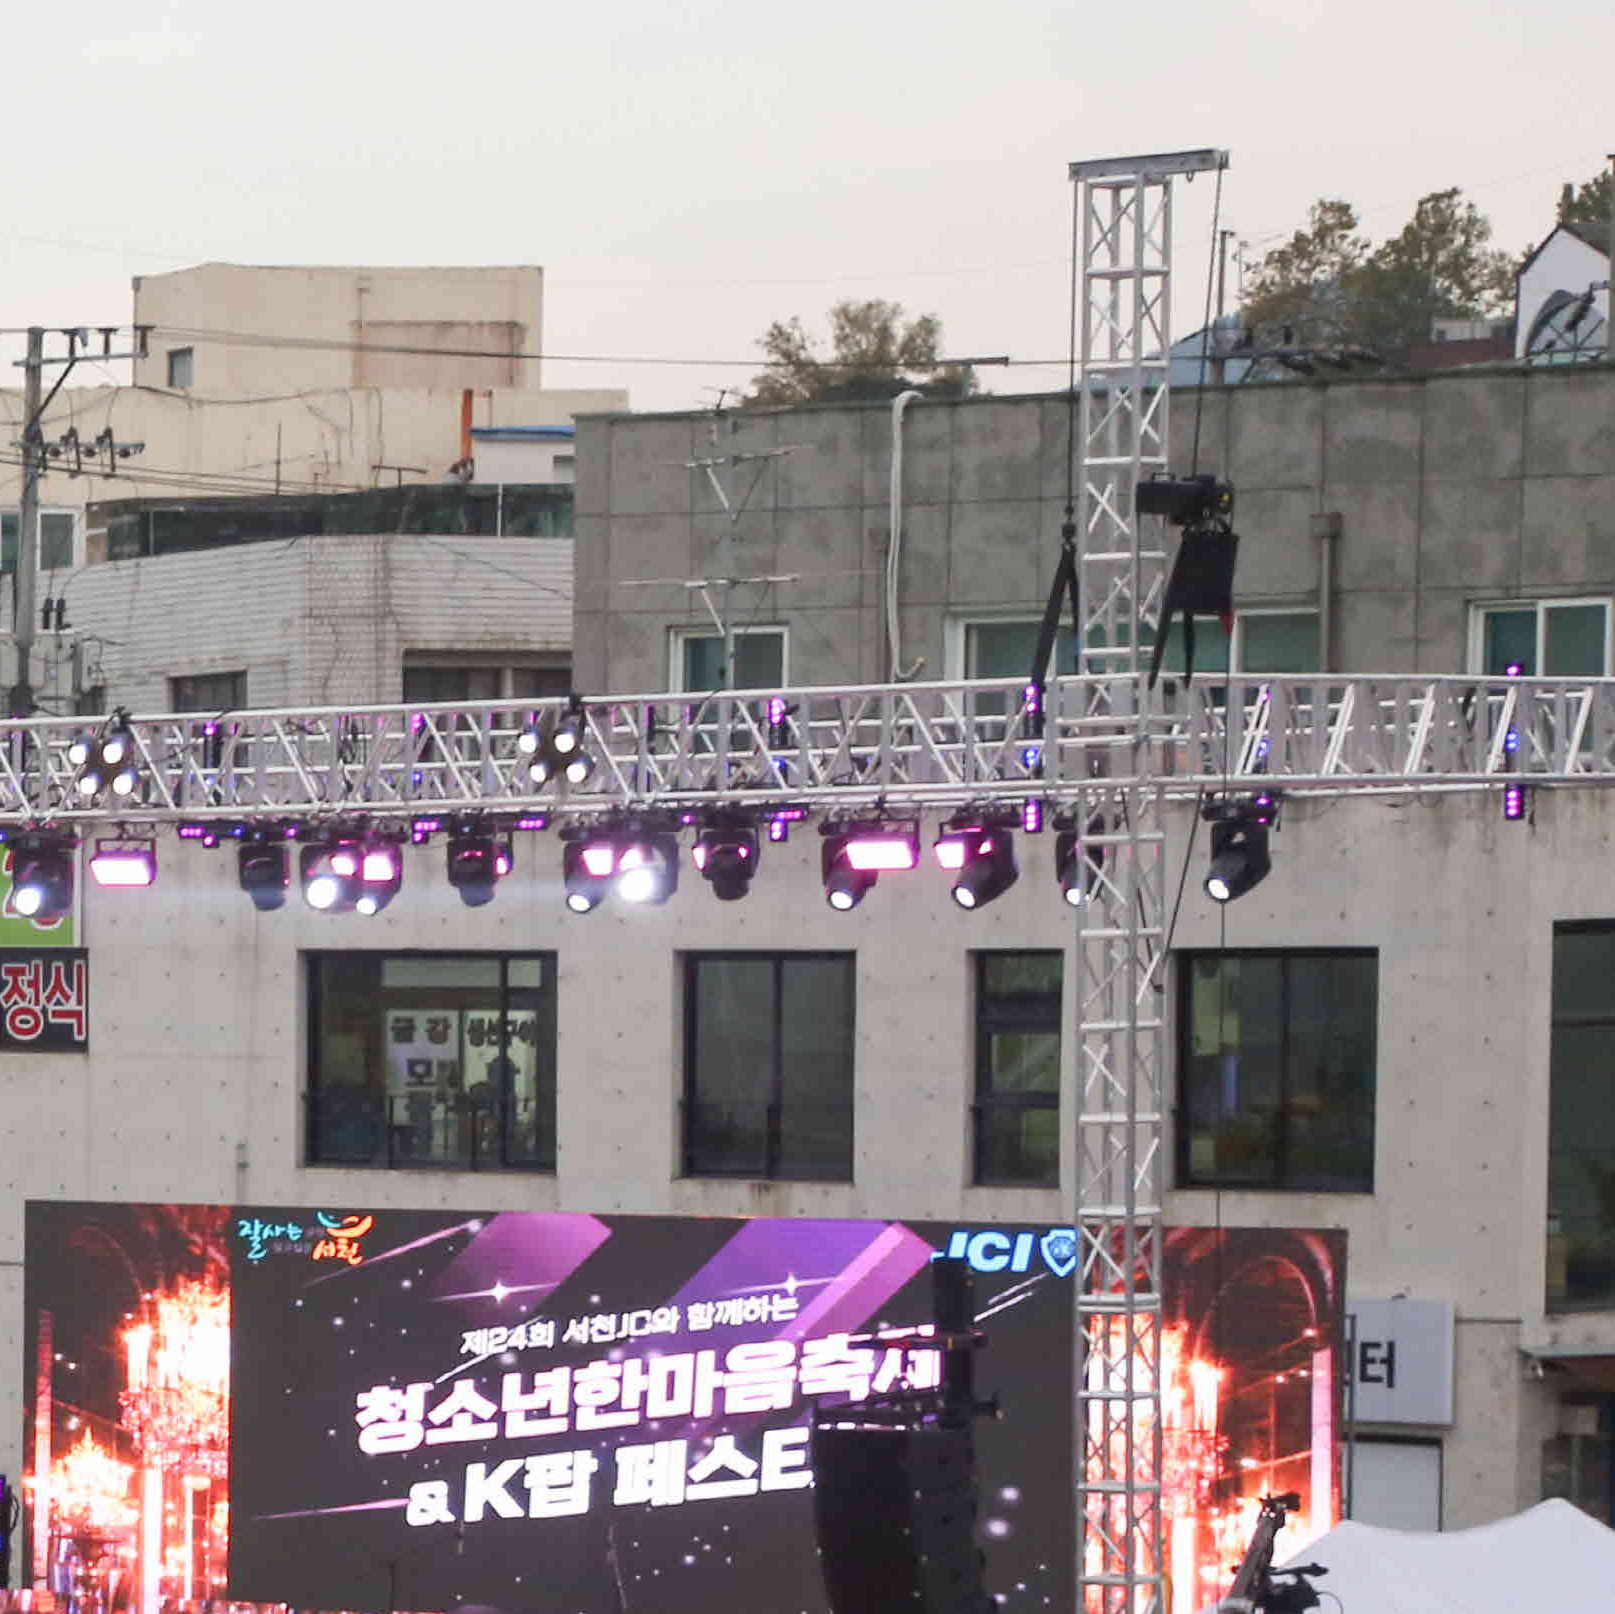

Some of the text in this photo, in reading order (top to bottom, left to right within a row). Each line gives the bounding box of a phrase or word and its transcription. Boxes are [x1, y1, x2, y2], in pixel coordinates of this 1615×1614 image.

[237, 1218, 303, 1259] 잘사는
[311, 1238, 364, 1266] 서천
[460, 1294, 799, 1355] 제24회 서천JC와 함께하는
[405, 1479, 456, 1528] &
